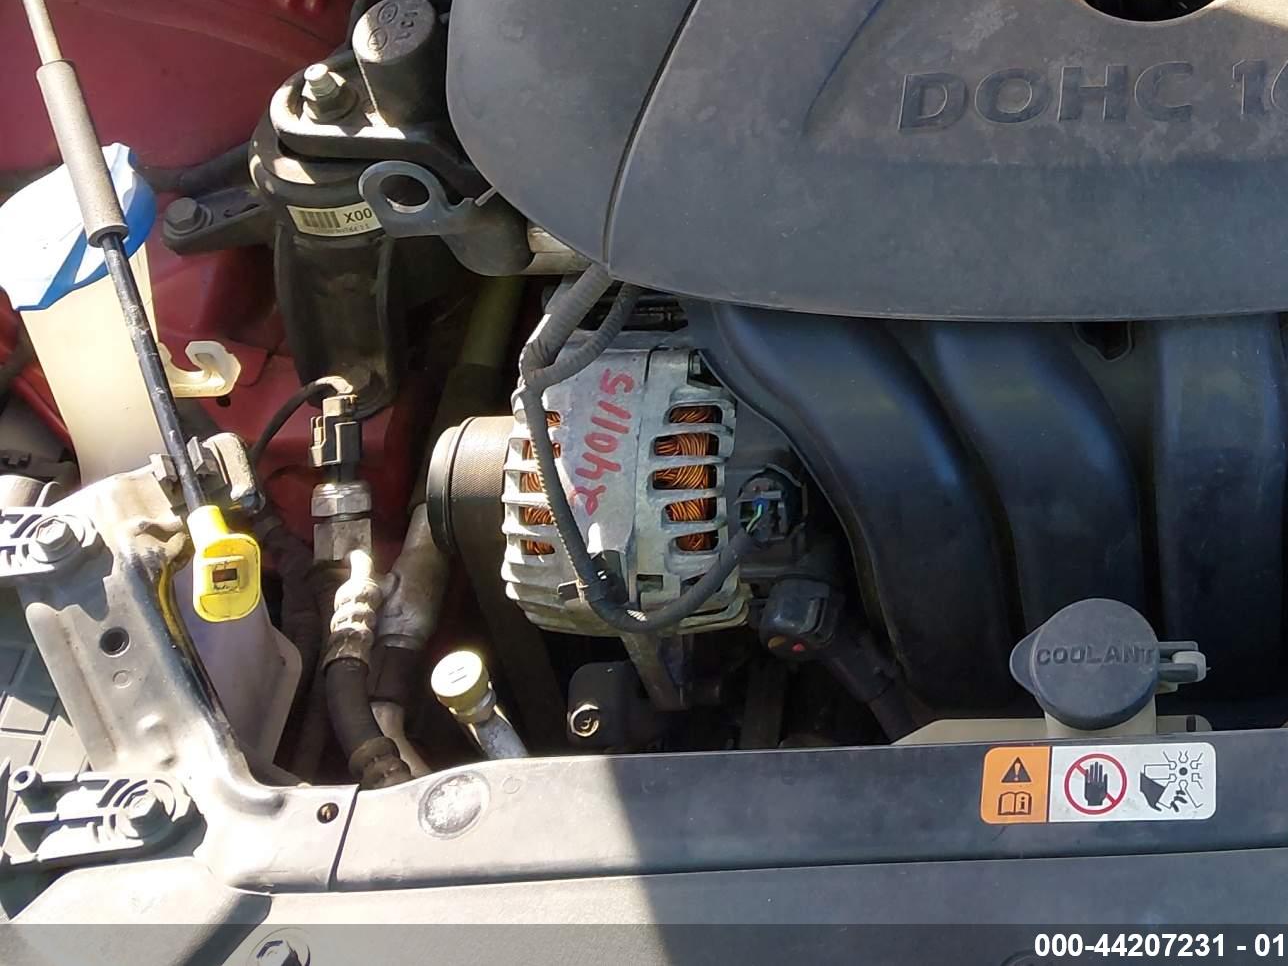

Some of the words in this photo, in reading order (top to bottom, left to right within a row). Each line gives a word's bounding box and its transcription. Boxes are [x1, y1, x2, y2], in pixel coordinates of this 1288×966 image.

[898, 61, 1194, 132] DOHC
[343, 207, 373, 224] X00
[574, 367, 635, 517] 240115
[1036, 643, 1155, 667] COOLANT
